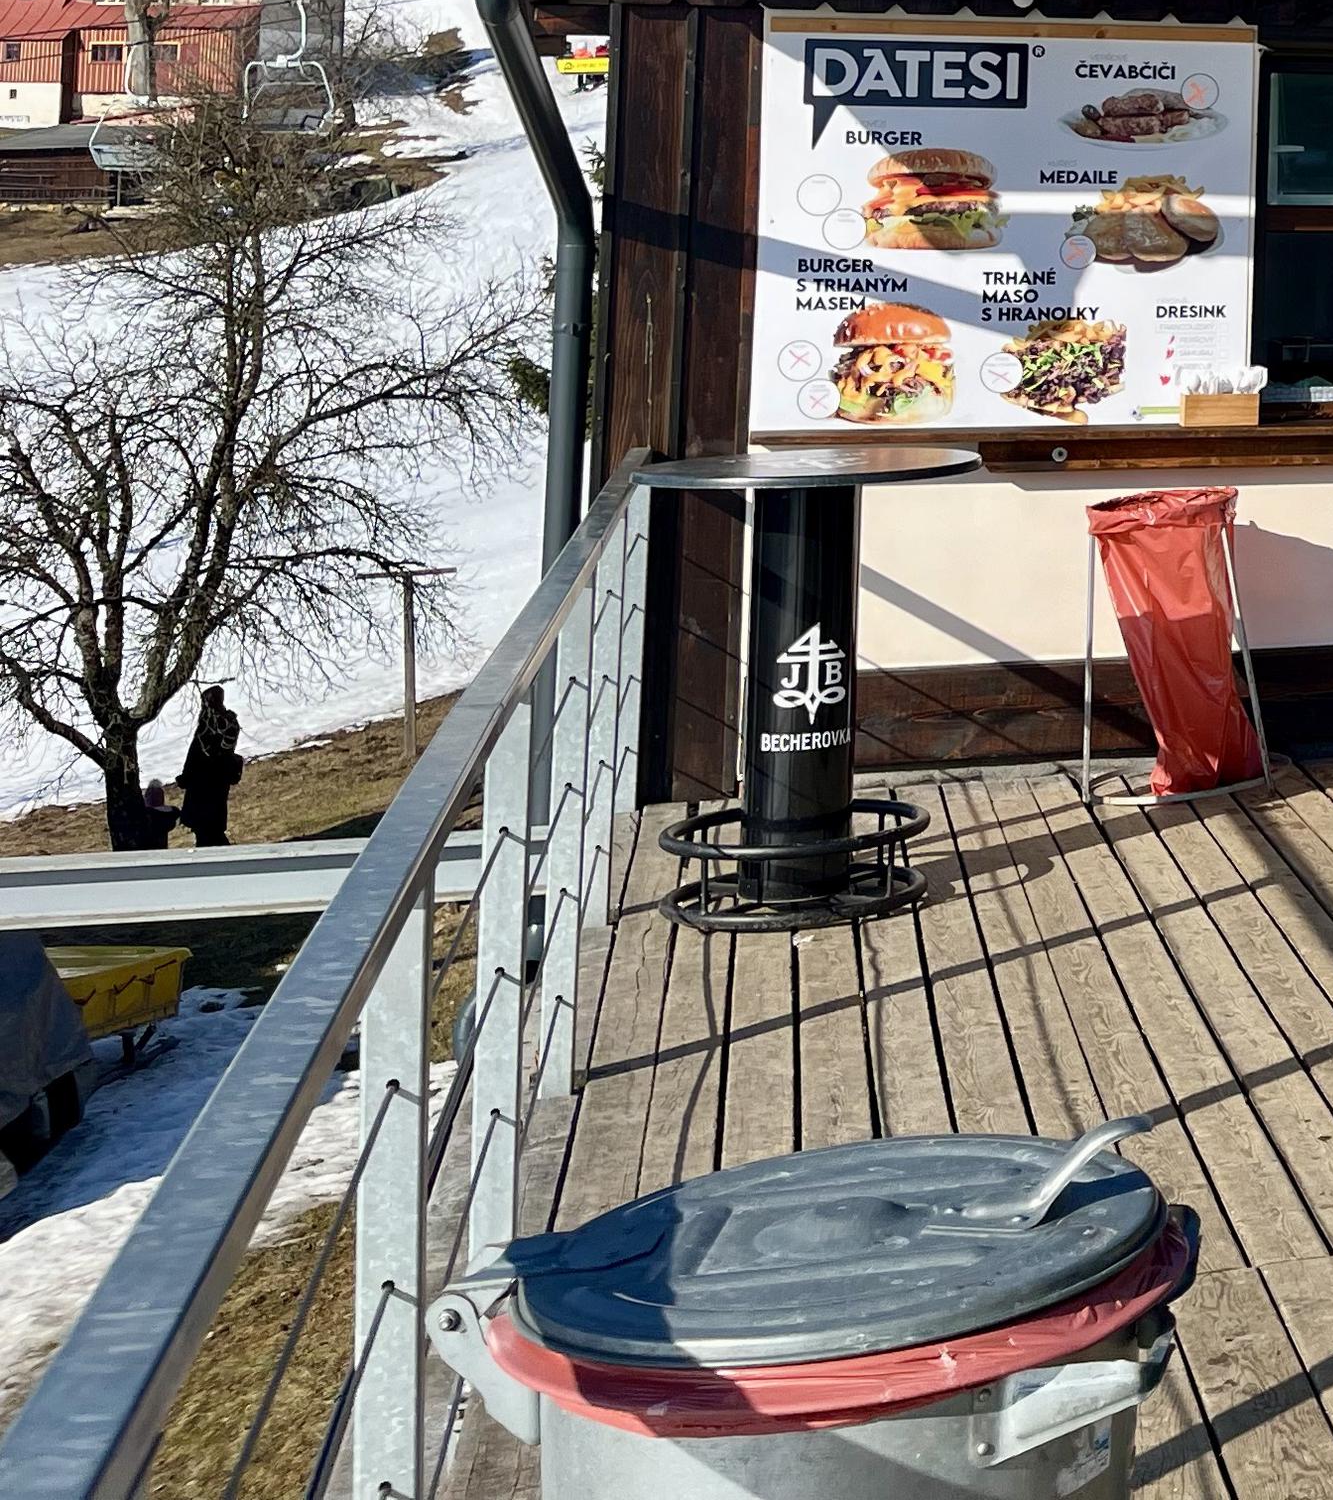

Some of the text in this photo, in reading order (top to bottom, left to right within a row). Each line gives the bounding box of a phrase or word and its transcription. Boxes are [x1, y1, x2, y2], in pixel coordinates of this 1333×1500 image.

[812, 47, 1020, 100] DATESI
[1075, 60, 1176, 80] ČEVABČIČI
[845, 131, 923, 146] BURGER
[1040, 170, 1118, 184] MEDAILE
[797, 258, 874, 273] BURGER
[796, 274, 908, 293] S TRHANÝM
[983, 267, 1057, 285] TRHANÉ
[796, 296, 866, 311] MASEM
[982, 289, 1039, 304] MASO
[981, 306, 1099, 322] S HRANOLKY
[1156, 304, 1227, 319] DRESINK
[760, 728, 852, 752] BECHEROVKA
